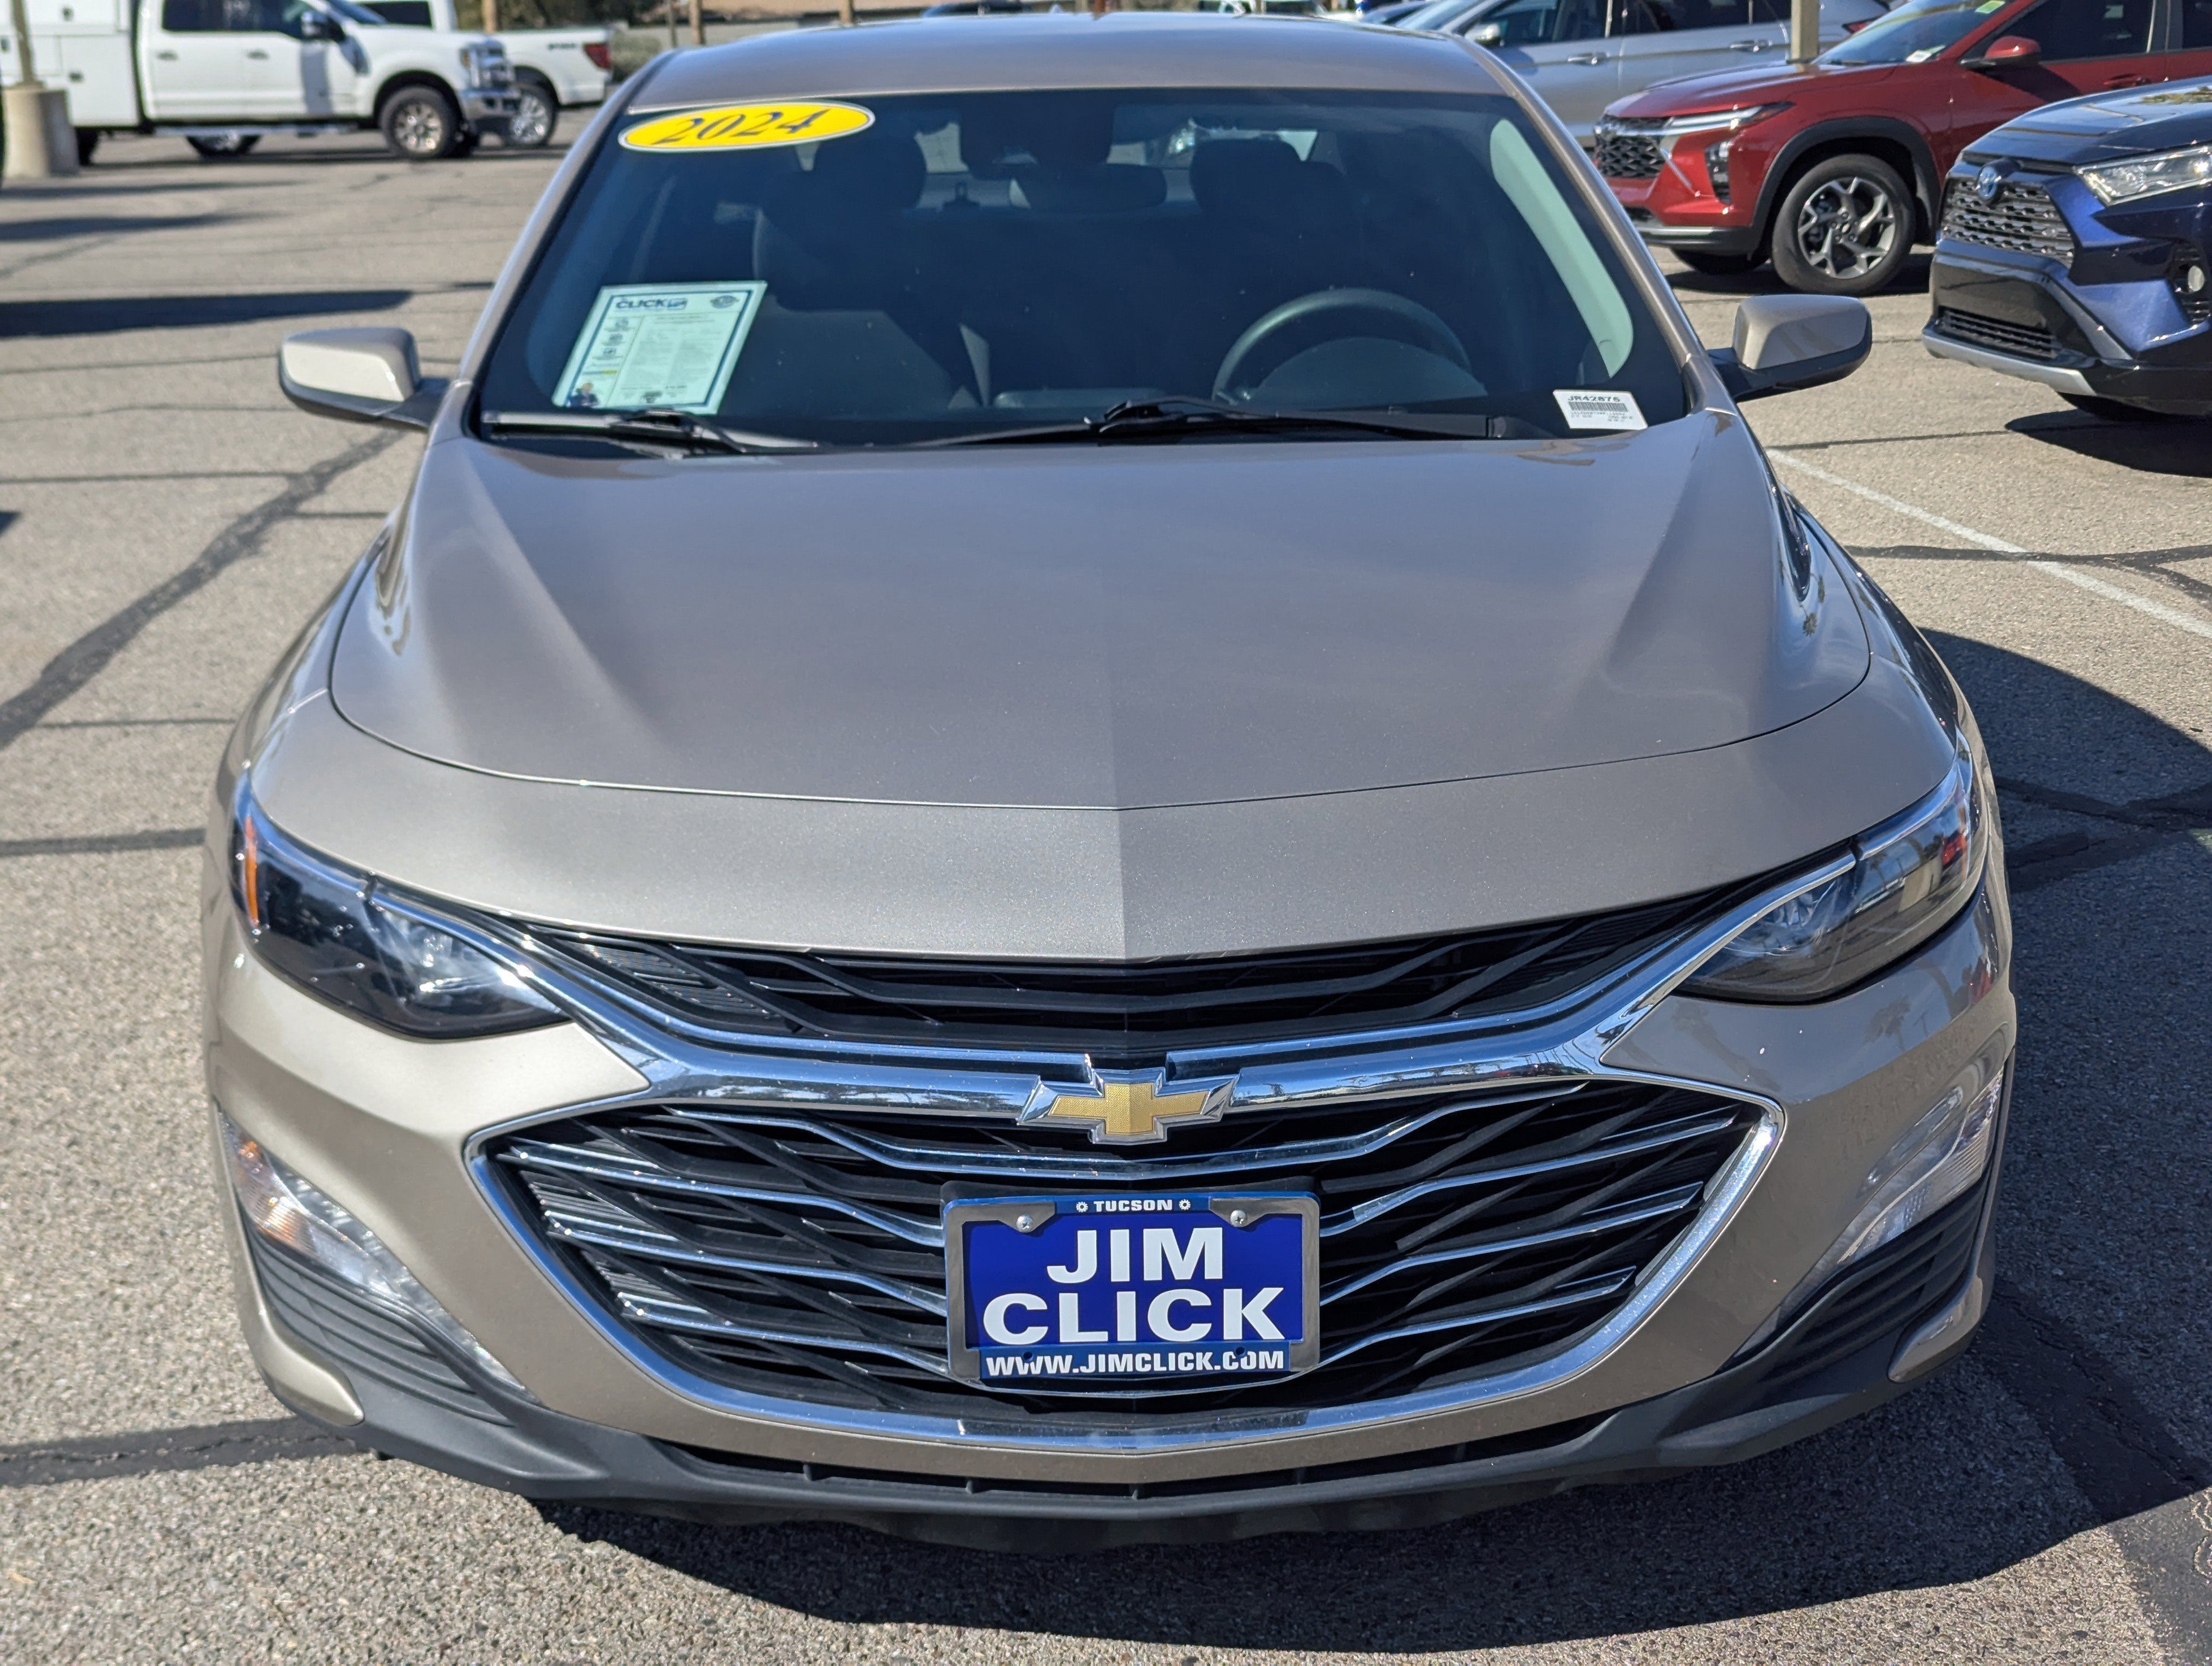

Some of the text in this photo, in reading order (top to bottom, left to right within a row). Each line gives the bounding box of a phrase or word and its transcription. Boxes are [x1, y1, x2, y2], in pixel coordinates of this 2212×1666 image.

[651, 110, 831, 145] 2024
[1094, 1199, 1173, 1213] TUCSON
[1046, 1227, 1224, 1285] JIM
[982, 1287, 1285, 1345] CLICK
[986, 1350, 1284, 1377] WWW.JIMCLICK.COM
